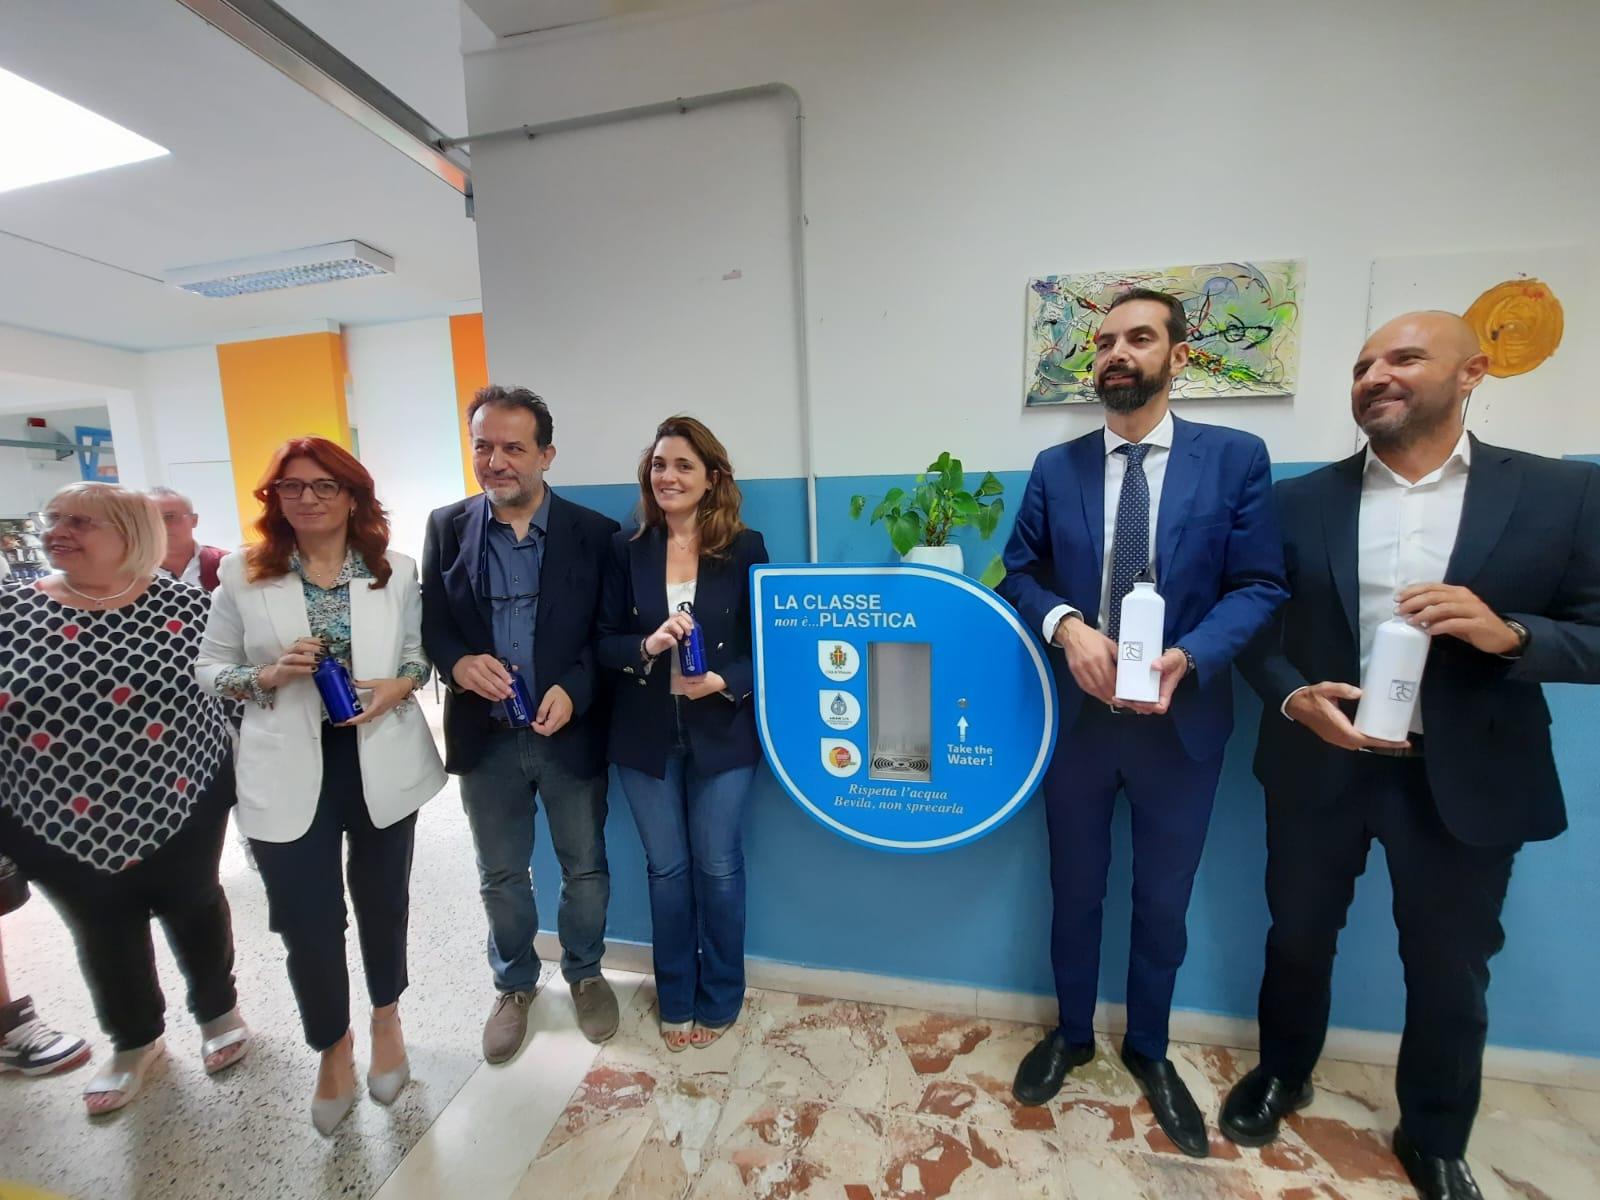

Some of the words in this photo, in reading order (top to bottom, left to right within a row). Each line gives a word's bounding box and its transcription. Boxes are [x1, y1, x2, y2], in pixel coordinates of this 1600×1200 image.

[774, 594, 799, 610] LA
[803, 594, 881, 610] CLASSE
[774, 617, 798, 627] non
[947, 744, 972, 754] Take
[974, 744, 993, 755] the
[849, 783, 897, 797] Rispetta
[878, 800, 902, 811] non
[906, 802, 964, 815] sprecarla
